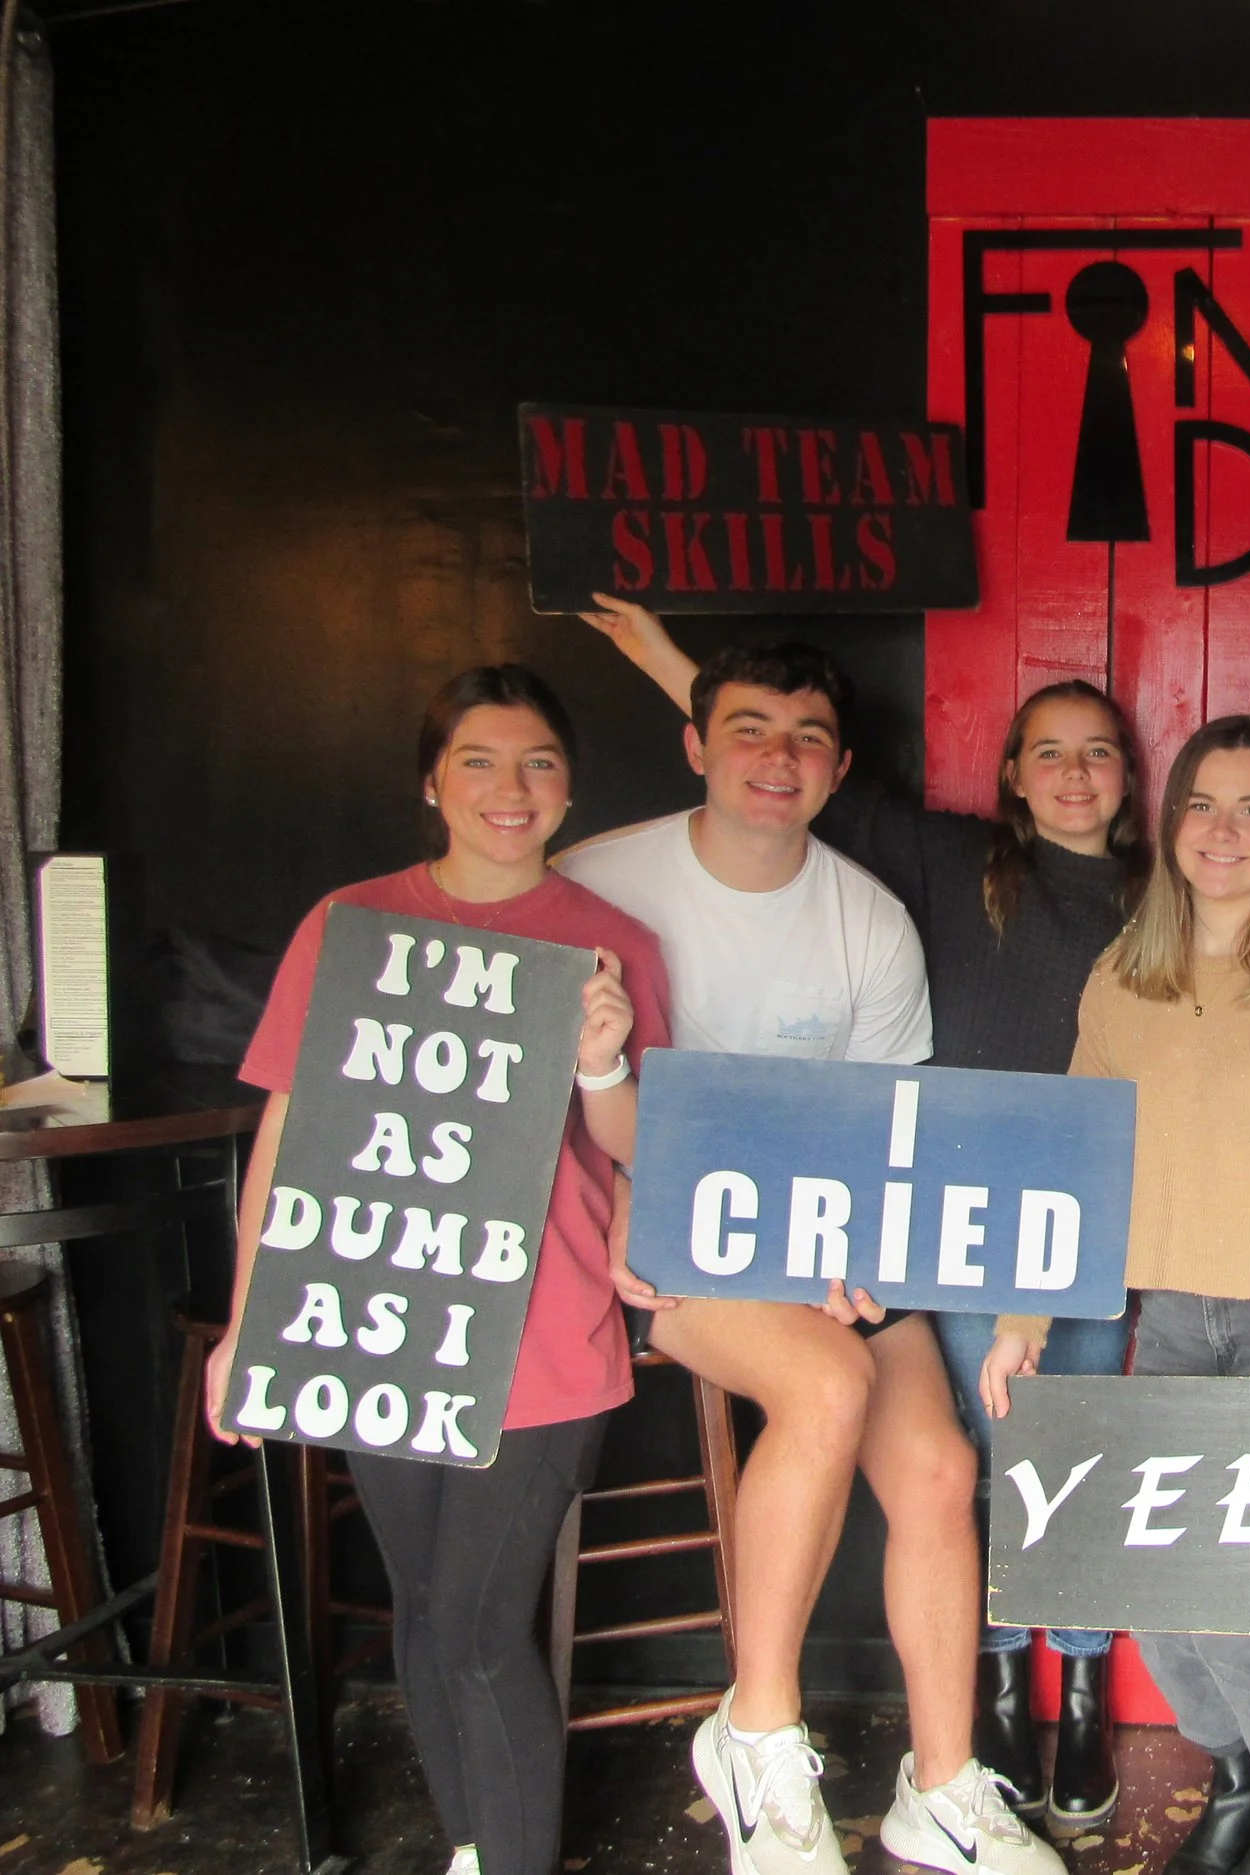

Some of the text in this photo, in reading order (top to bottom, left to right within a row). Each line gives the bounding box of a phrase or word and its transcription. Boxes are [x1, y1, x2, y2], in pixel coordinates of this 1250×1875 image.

[527, 416, 956, 507] MAD TEAM
[610, 509, 897, 591] SKILLS
[376, 933, 520, 1015] I'M
[342, 1018, 523, 1103] NOT
[351, 1112, 473, 1184] AS
[888, 1080, 920, 1168] I
[260, 1186, 529, 1283] DUMB
[690, 1170, 1081, 1291] CRIED
[281, 1282, 475, 1367] AS I
[236, 1365, 478, 1459] LOOK
